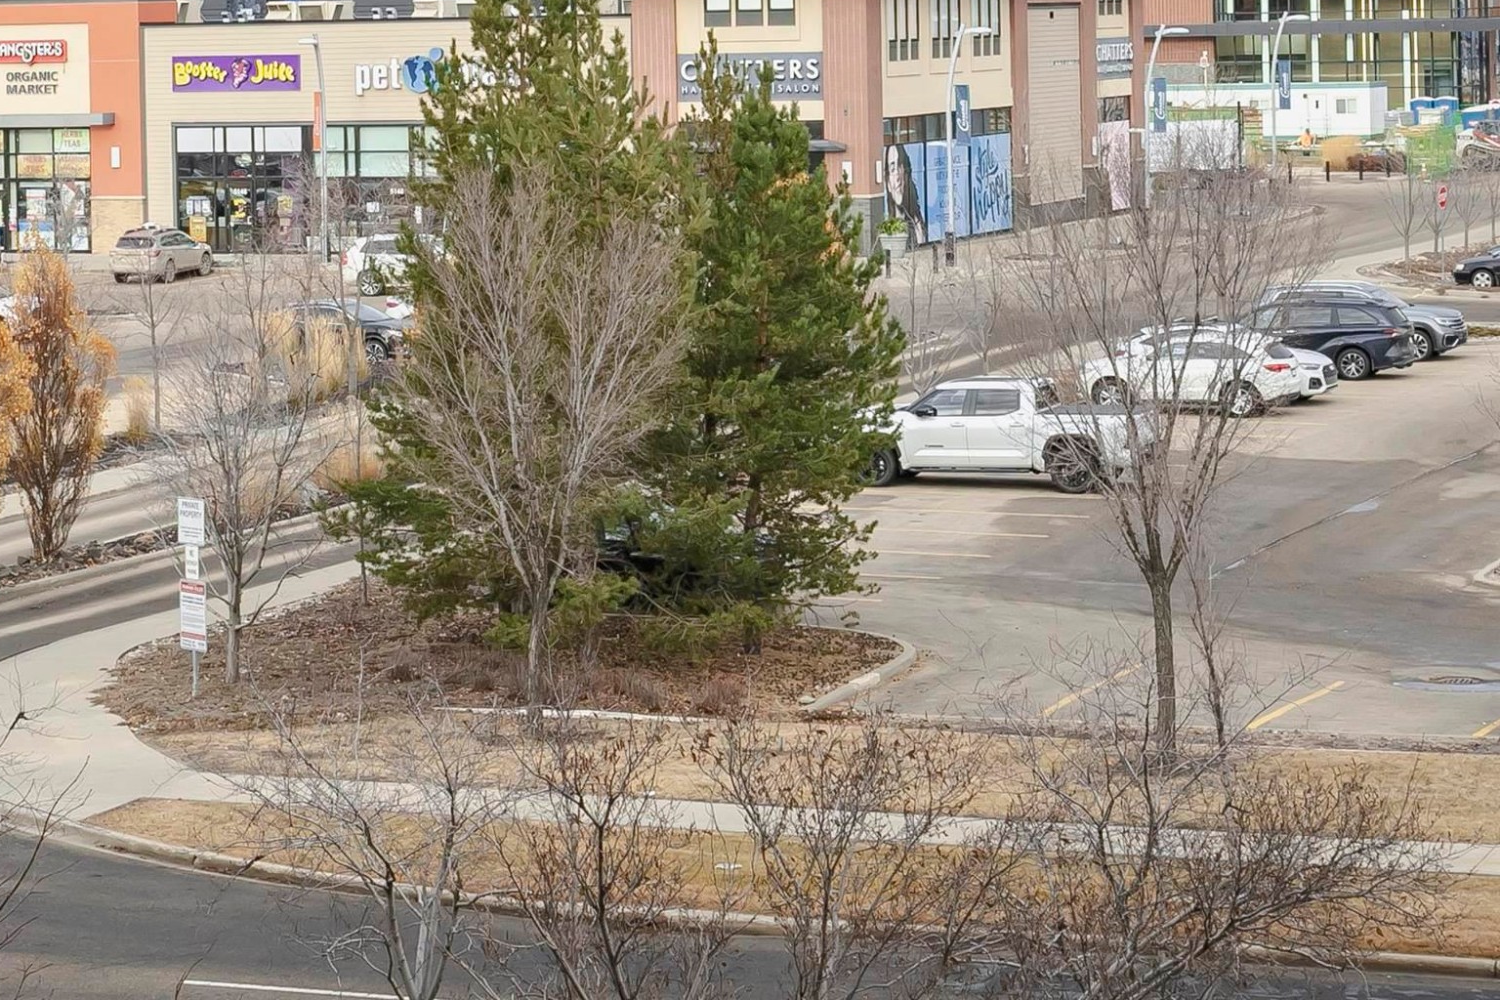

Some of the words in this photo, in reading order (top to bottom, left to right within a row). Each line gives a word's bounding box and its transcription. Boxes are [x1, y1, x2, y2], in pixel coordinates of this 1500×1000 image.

[6, 71, 59, 82] ORGANIC
[174, 60, 227, 85] Booster
[251, 59, 295, 83] Juice
[6, 84, 58, 95] MARKET
[777, 85, 820, 94] SALON
